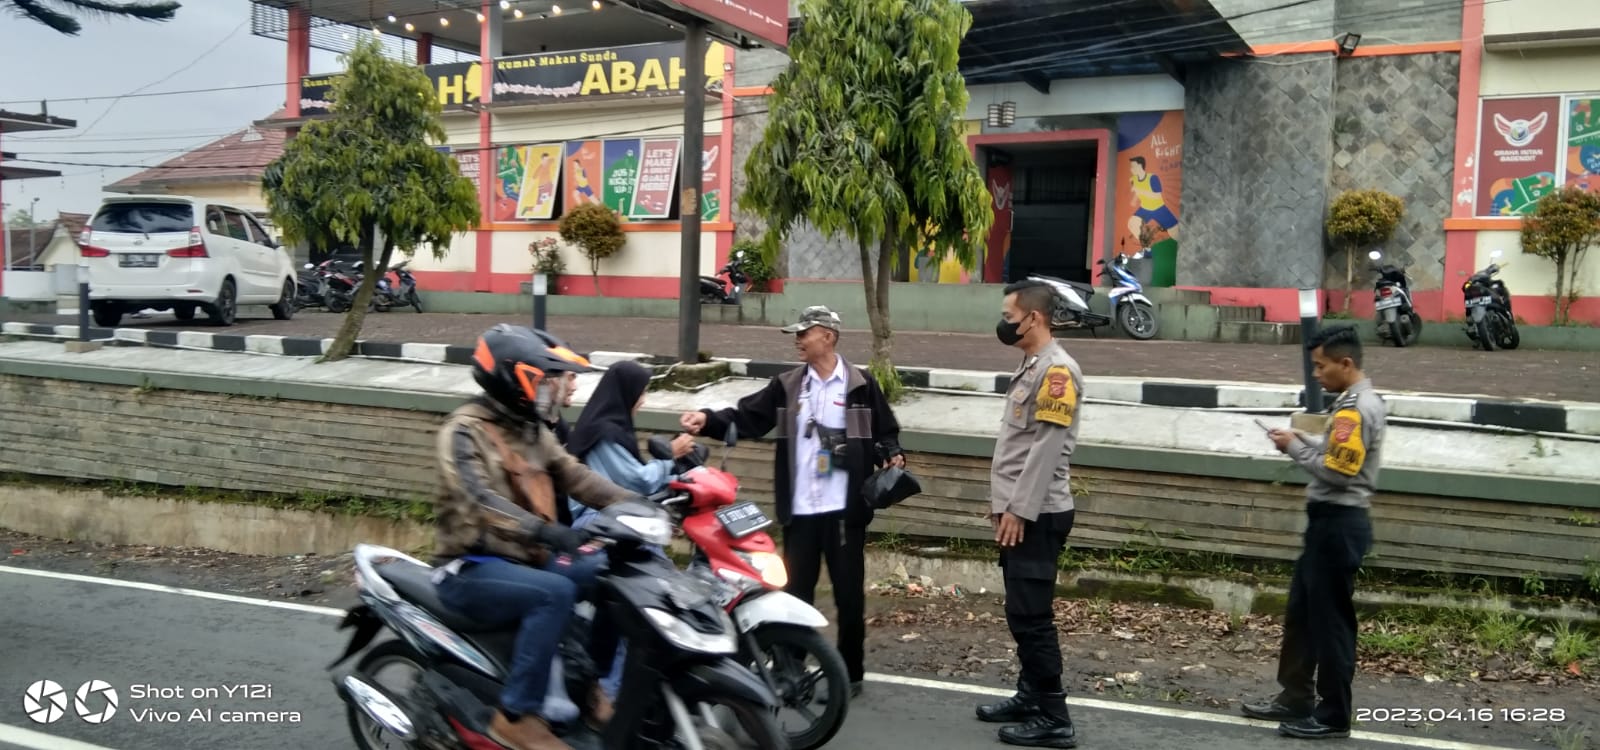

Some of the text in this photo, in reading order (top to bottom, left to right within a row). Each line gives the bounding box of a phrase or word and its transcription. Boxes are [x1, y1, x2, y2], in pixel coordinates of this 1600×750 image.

[539, 55, 577, 66] Makan
[580, 50, 618, 63] Sunda
[1151, 135, 1168, 149] ALL
[1155, 144, 1181, 159] RIGHT
[645, 158, 672, 167] MAKE
